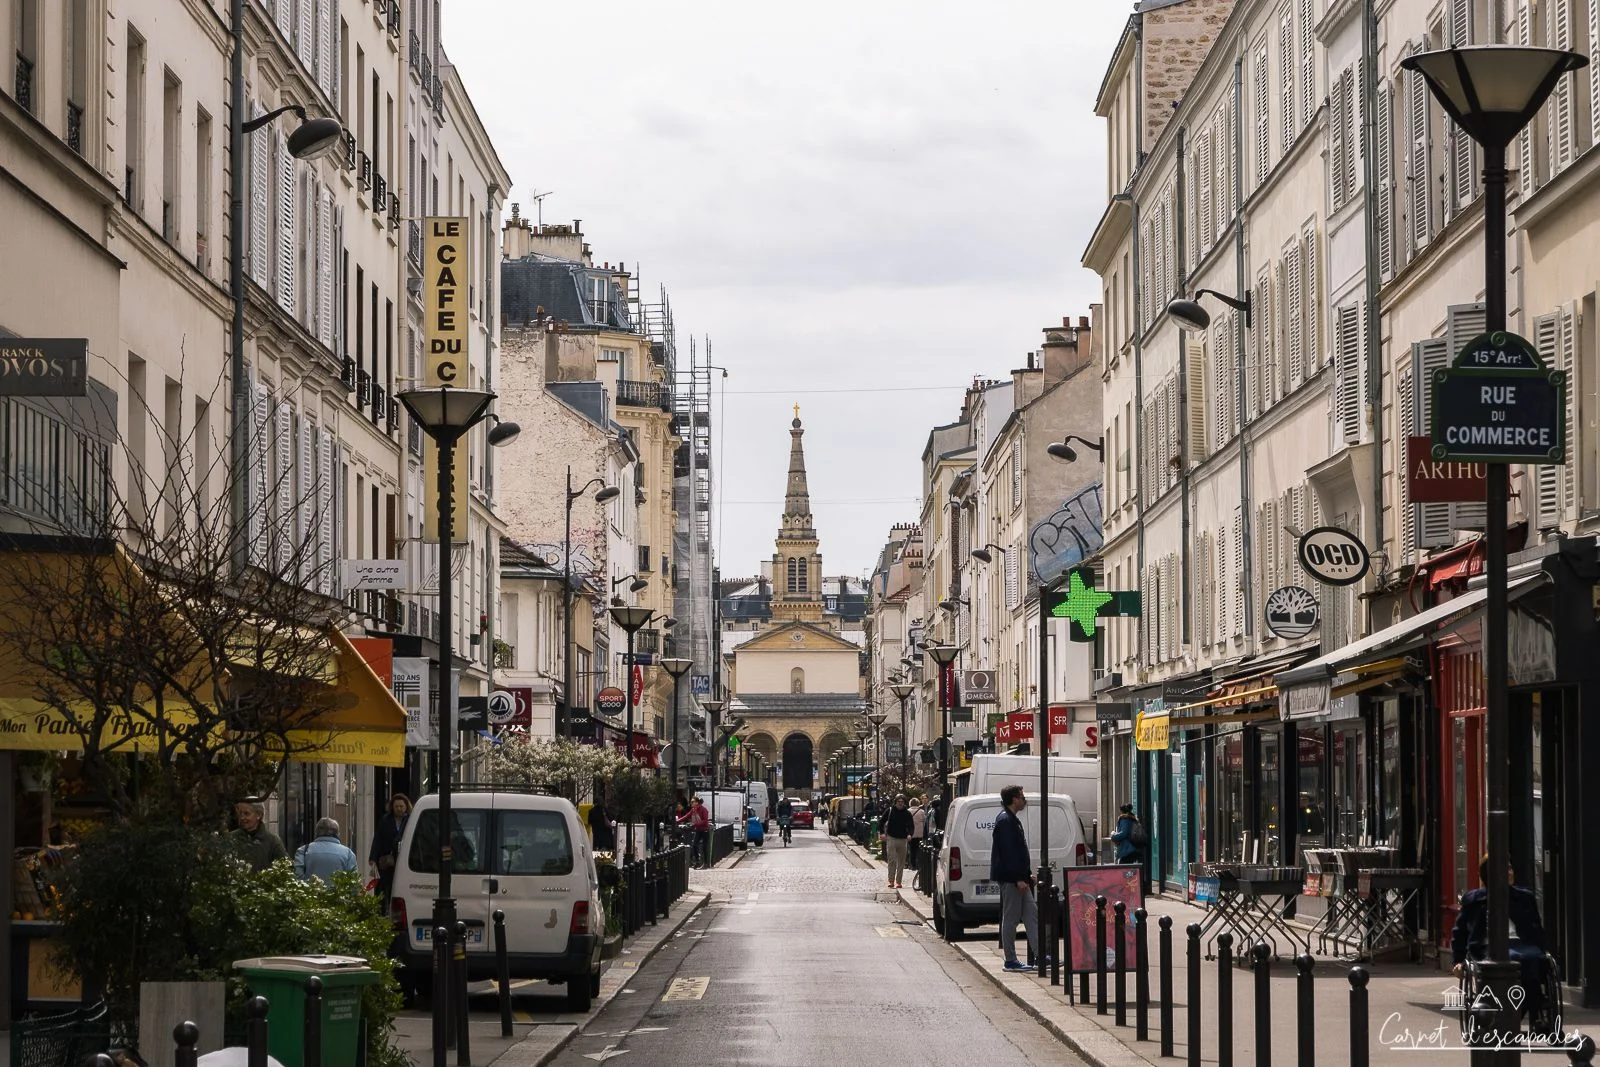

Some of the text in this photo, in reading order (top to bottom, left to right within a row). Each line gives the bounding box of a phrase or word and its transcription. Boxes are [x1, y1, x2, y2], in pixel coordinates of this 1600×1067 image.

[433, 222, 460, 238] LE
[435, 244, 458, 332] CAFE
[0, 348, 43, 358] RANCK
[430, 339, 462, 355] DU
[1480, 386, 1517, 405] RUE
[1490, 410, 1506, 422] DU
[1446, 425, 1550, 446] COMMERCE
[1414, 459, 1488, 479] ARTHU
[1306, 543, 1361, 566] OCD
[34, 713, 97, 735] Panie
[1013, 721, 1033, 731] SFR
[1054, 715, 1067, 726] SFR
[1085, 726, 1098, 748] S
[976, 821, 996, 830] Lusa
